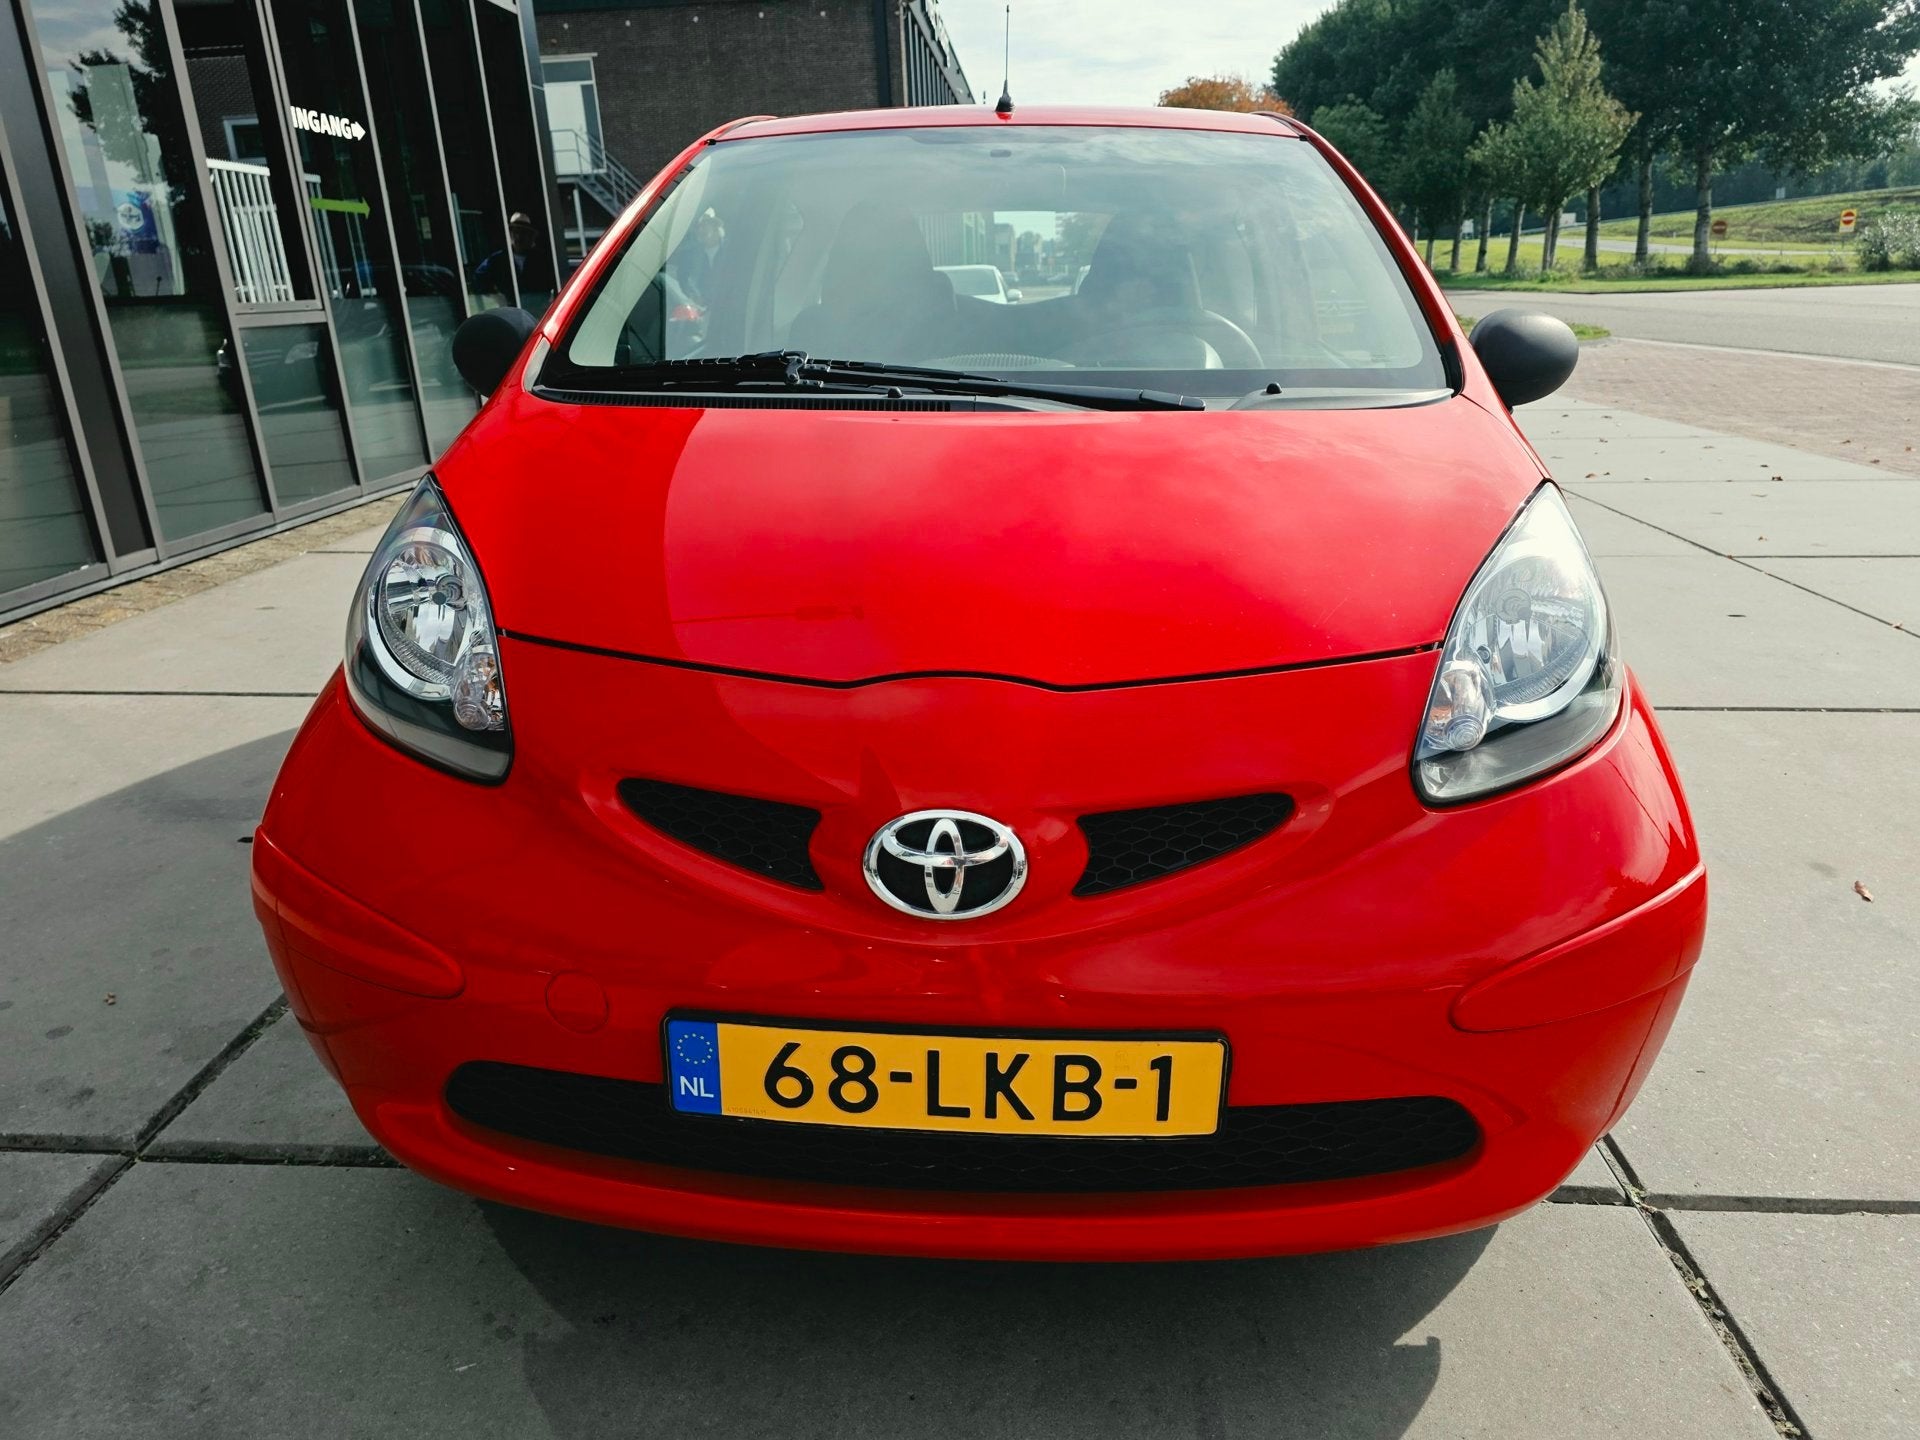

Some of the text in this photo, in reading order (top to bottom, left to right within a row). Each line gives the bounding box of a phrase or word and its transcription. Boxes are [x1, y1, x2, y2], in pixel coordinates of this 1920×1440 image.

[290, 105, 352, 140] INGANG
[679, 1075, 715, 1098] NL
[764, 1042, 1172, 1122] 68-LKB-1
